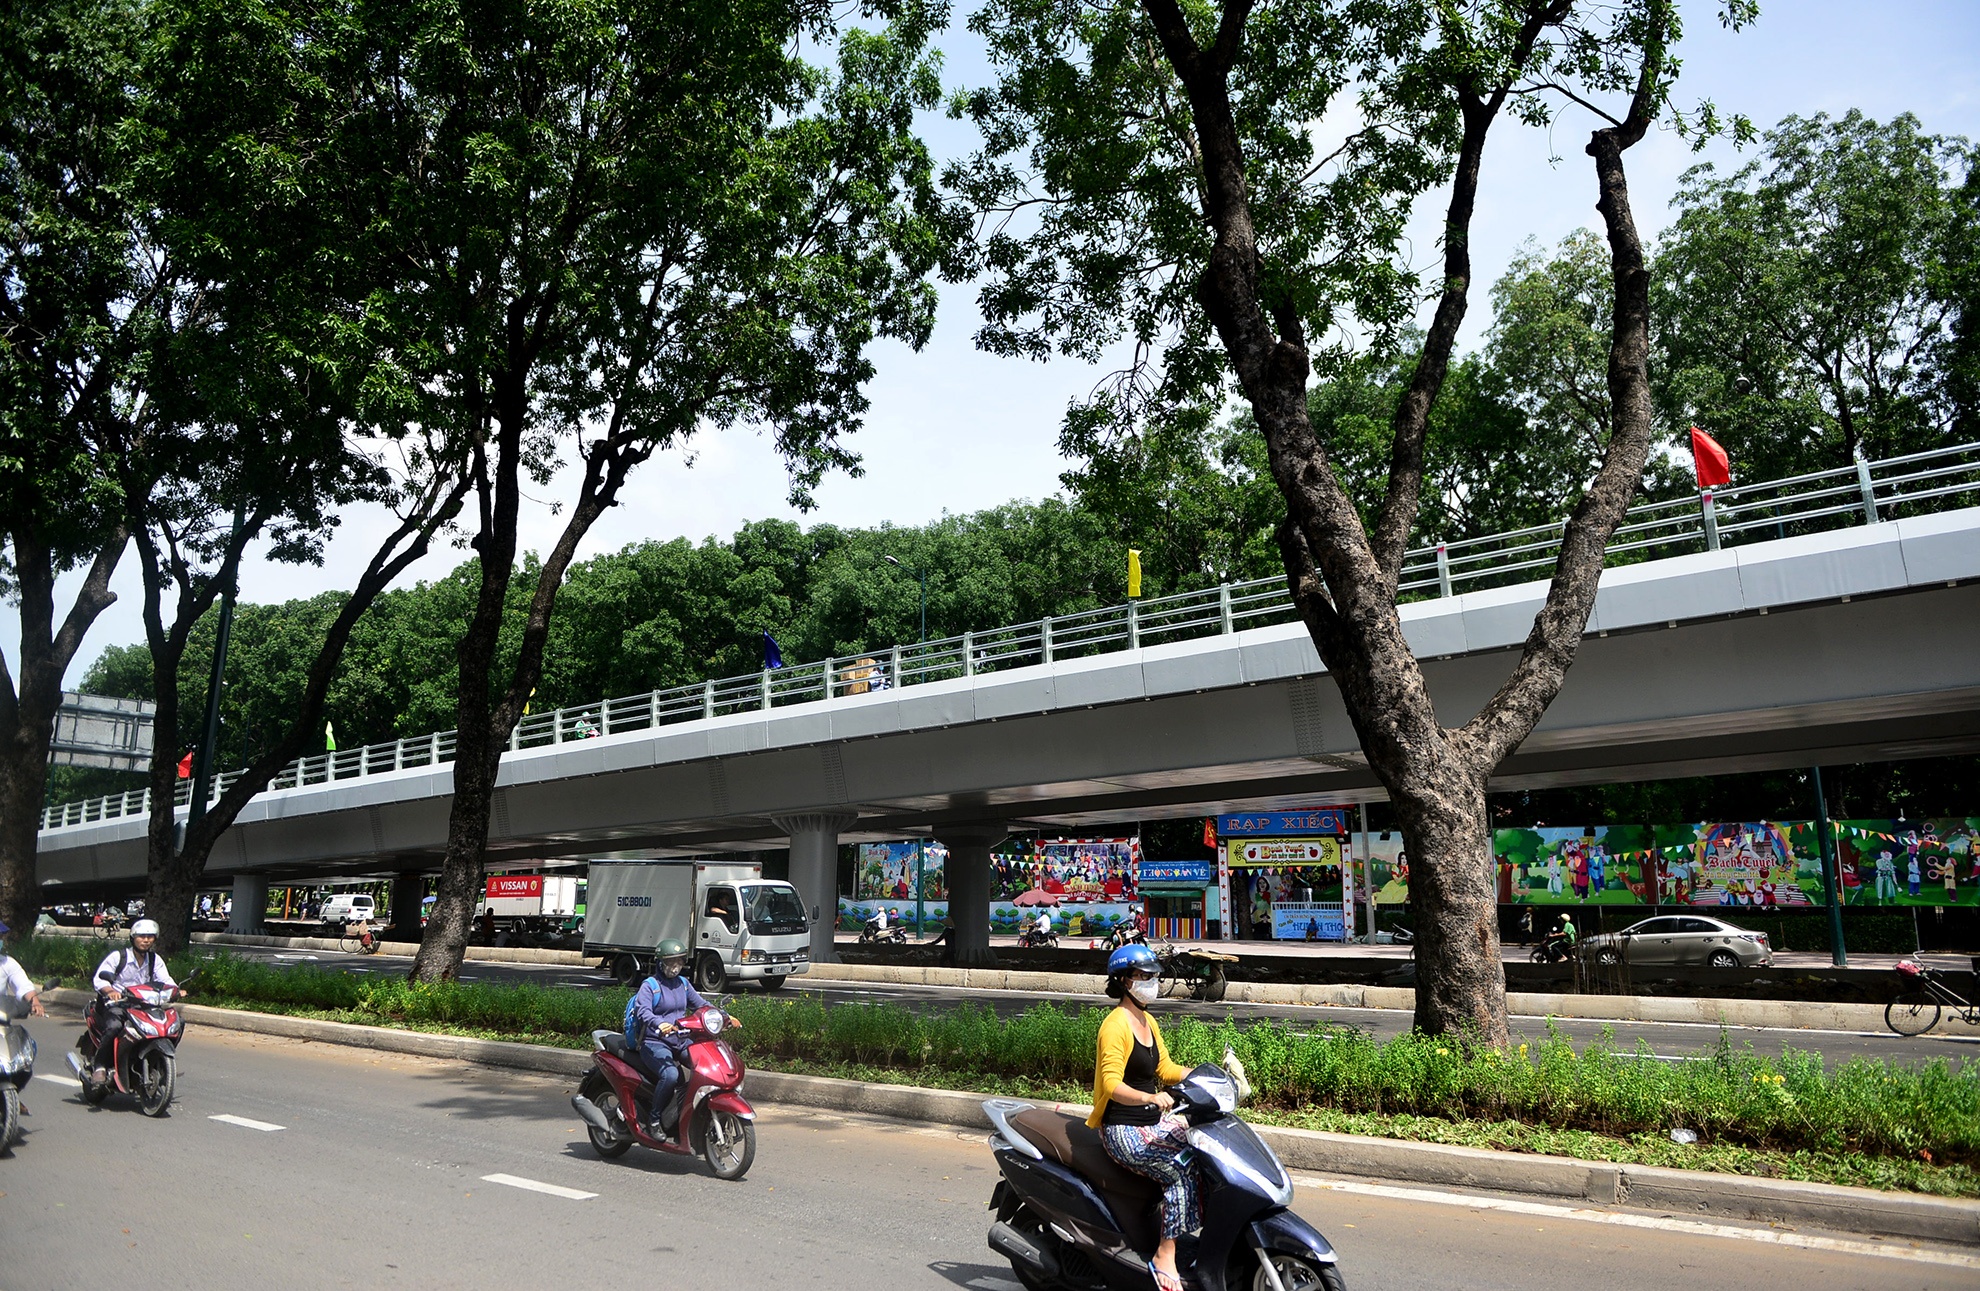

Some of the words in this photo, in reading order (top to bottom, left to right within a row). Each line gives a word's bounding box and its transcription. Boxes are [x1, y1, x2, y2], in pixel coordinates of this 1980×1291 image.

[1227, 818, 1271, 832] RẠP
[1282, 812, 1334, 829] XIẾC
[500, 881, 528, 890] VISSAN
